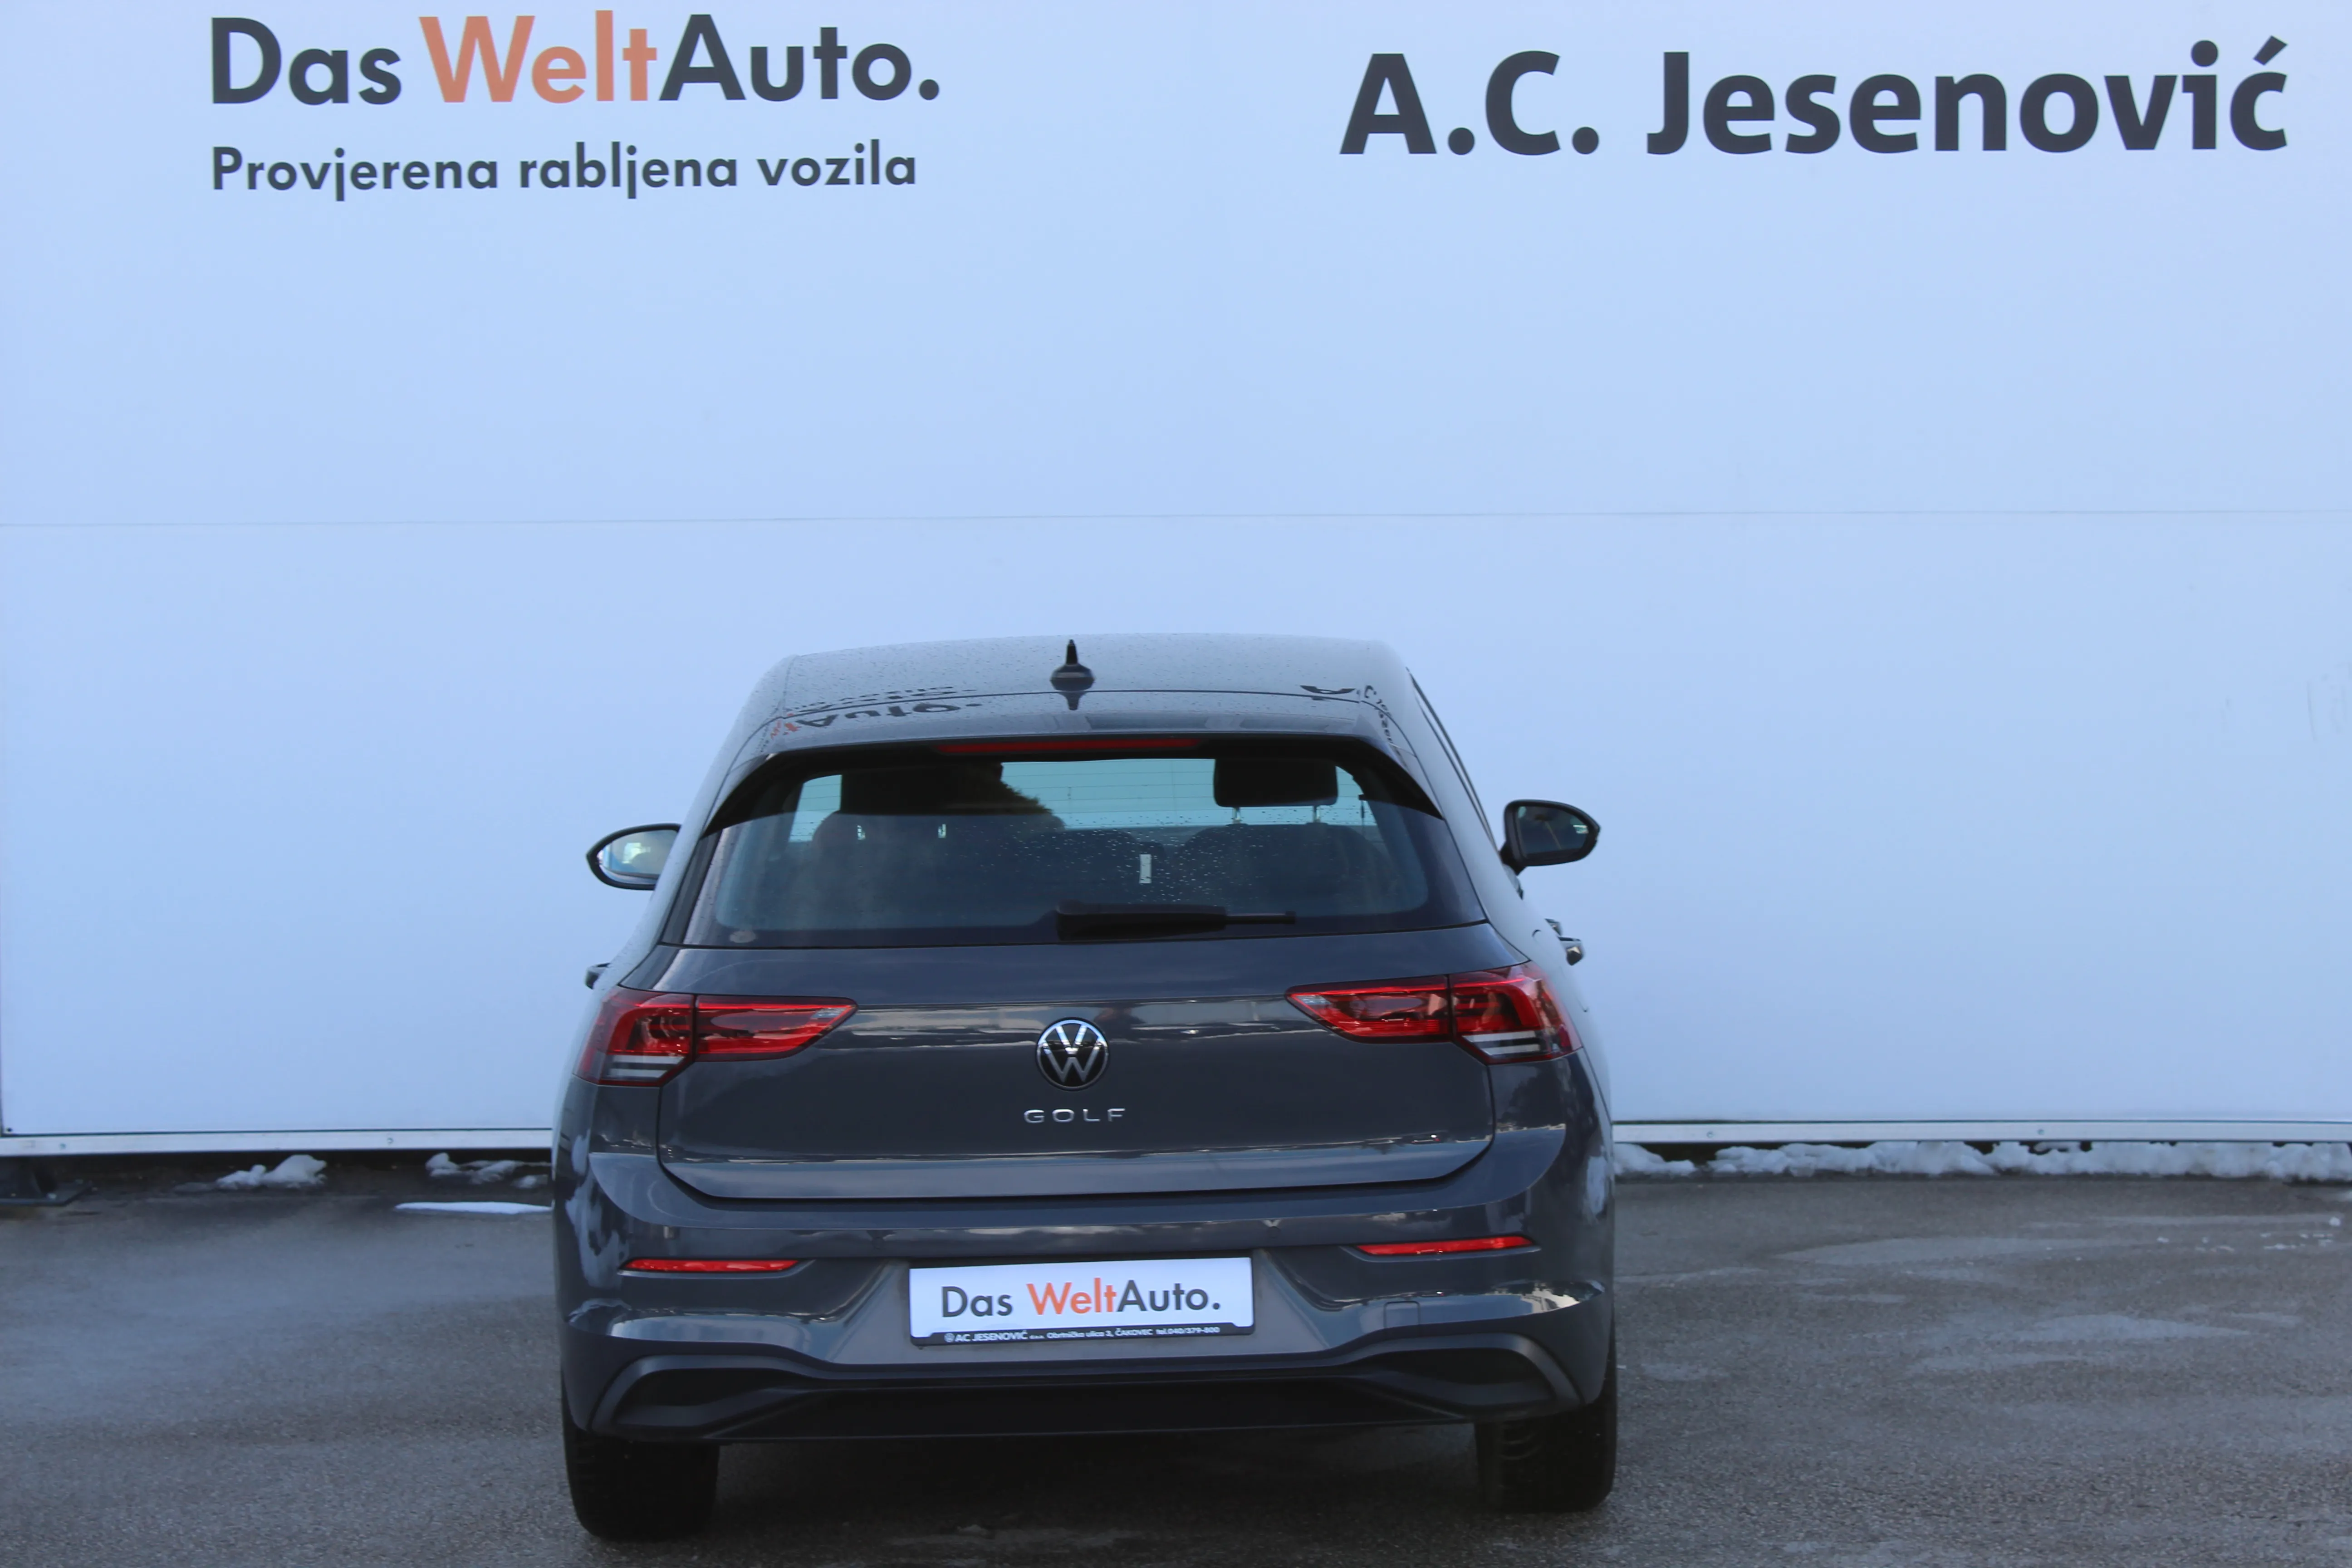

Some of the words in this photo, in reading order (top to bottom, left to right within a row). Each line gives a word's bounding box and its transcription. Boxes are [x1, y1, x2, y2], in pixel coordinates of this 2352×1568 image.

[211, 17, 401, 105] Das
[419, 10, 940, 103] WeltAuto.
[1340, 50, 1599, 156] A.C.
[1647, 36, 2288, 155] Jesenović
[212, 146, 497, 201] Provjerena
[519, 141, 737, 199] rabljena
[756, 138, 916, 186] vozila
[1023, 1108, 1126, 1123] GOLF
[942, 1286, 1012, 1318] Das
[1026, 1278, 1220, 1315] WeltAuto.
[955, 1333, 971, 1342] AC
[972, 1330, 1029, 1341] JESENOVIĆ
